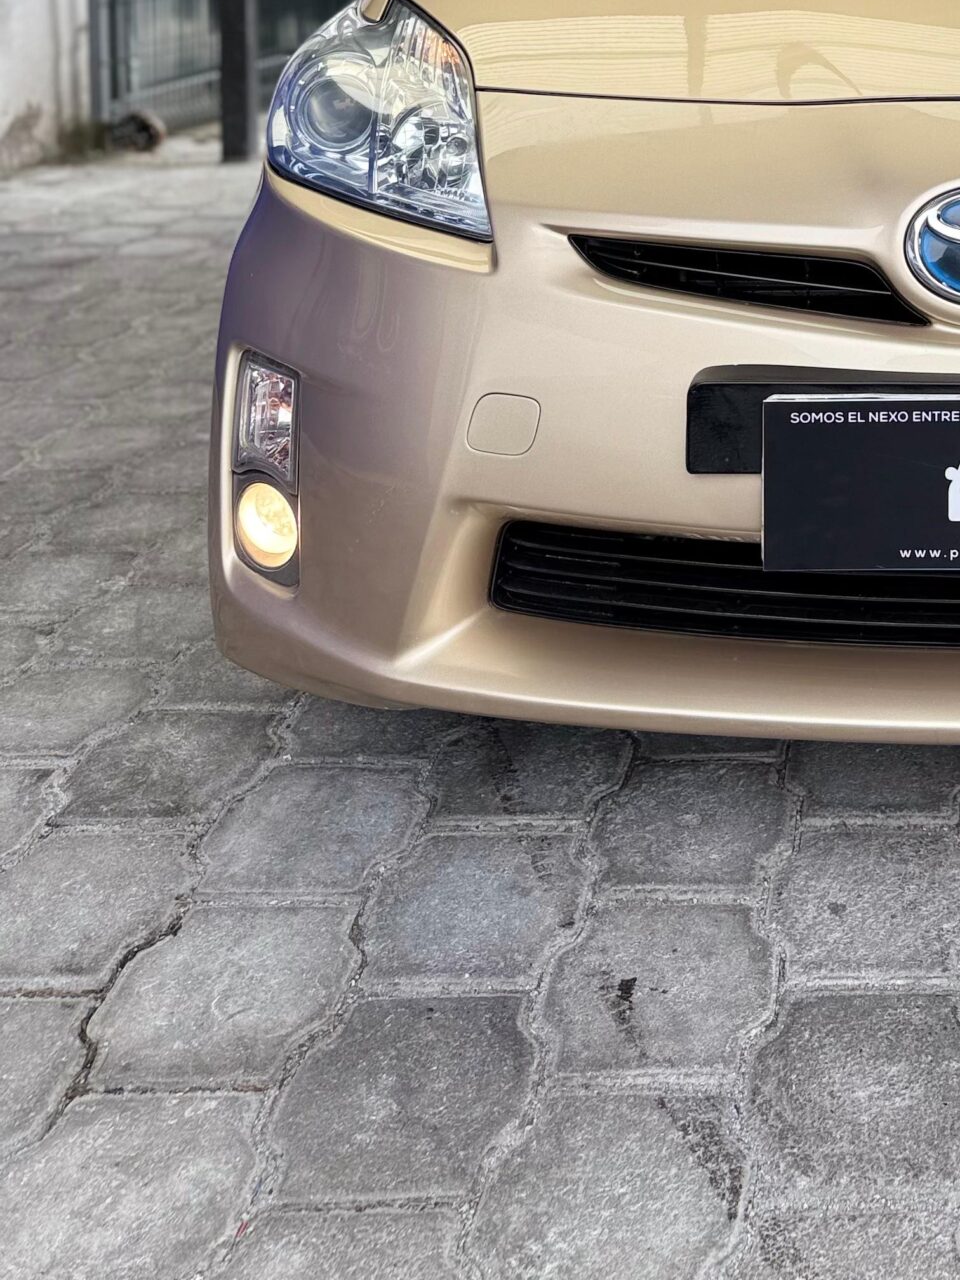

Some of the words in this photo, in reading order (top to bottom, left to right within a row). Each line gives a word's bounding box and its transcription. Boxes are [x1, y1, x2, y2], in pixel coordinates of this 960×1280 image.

[790, 411, 845, 424] SOMOS
[847, 411, 866, 423] EL
[868, 410, 909, 423] NEXO
[912, 410, 960, 423] ENTRE
